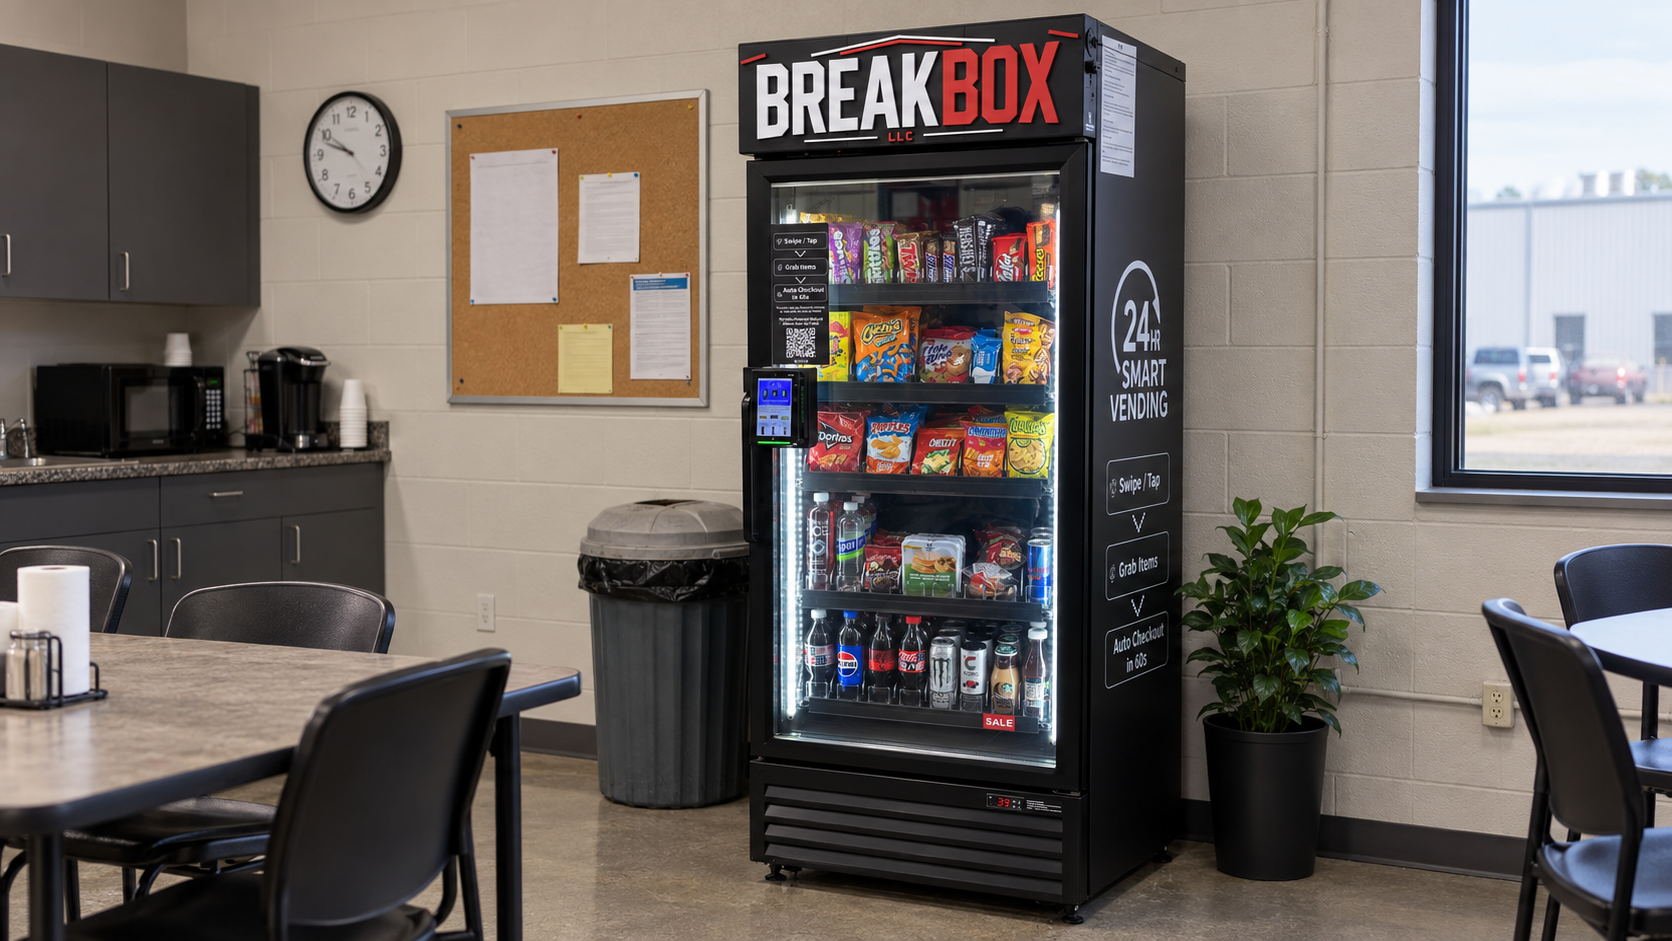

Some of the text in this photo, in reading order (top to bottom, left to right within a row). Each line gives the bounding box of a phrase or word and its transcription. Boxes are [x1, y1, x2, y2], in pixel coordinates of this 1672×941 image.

[756, 40, 1060, 140] BREAKBOX
[346, 106, 357, 118] 12
[365, 111, 369, 122] 1
[332, 113, 340, 125] 11
[321, 129, 332, 141] 10
[375, 124, 382, 137] 2
[887, 131, 914, 143] LLC
[317, 149, 324, 161] 9
[380, 144, 387, 157] 3
[321, 169, 329, 181] 8
[375, 165, 382, 177] 4
[334, 183, 340, 195] 7
[364, 181, 371, 194] 5
[348, 188, 356, 200] 6
[1121, 358, 1167, 389] SMART
[1110, 390, 1168, 422] VENDING
[1119, 475, 1142, 495] Swipe
[1147, 472, 1161, 491] Tap
[1119, 556, 1158, 578] Grab Items
[1113, 622, 1164, 655] Auto Checkout
[1126, 652, 1148, 673] in 60s
[985, 717, 1014, 728] SALE
[997, 797, 1011, 808] 39
